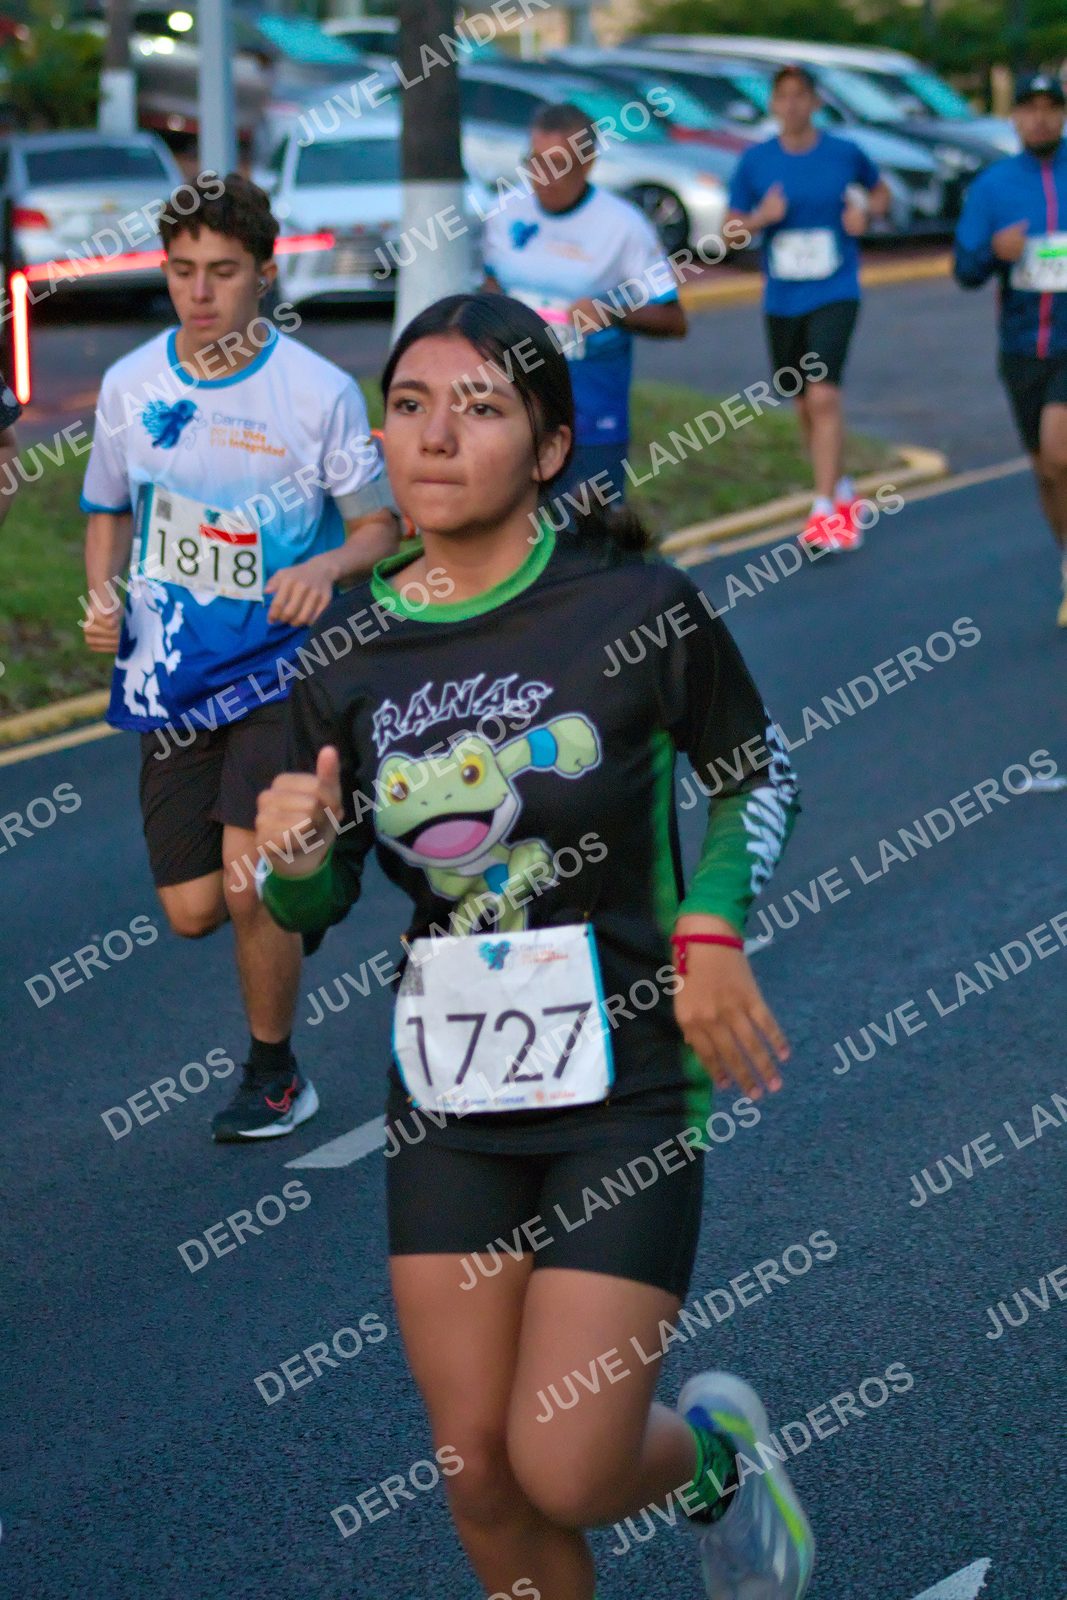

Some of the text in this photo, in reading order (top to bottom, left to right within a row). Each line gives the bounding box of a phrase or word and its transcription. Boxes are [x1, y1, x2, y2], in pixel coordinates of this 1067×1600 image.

[158, 529, 257, 588] 1818
[372, 673, 554, 757] RANAS
[406, 1001, 593, 1087] 1727
